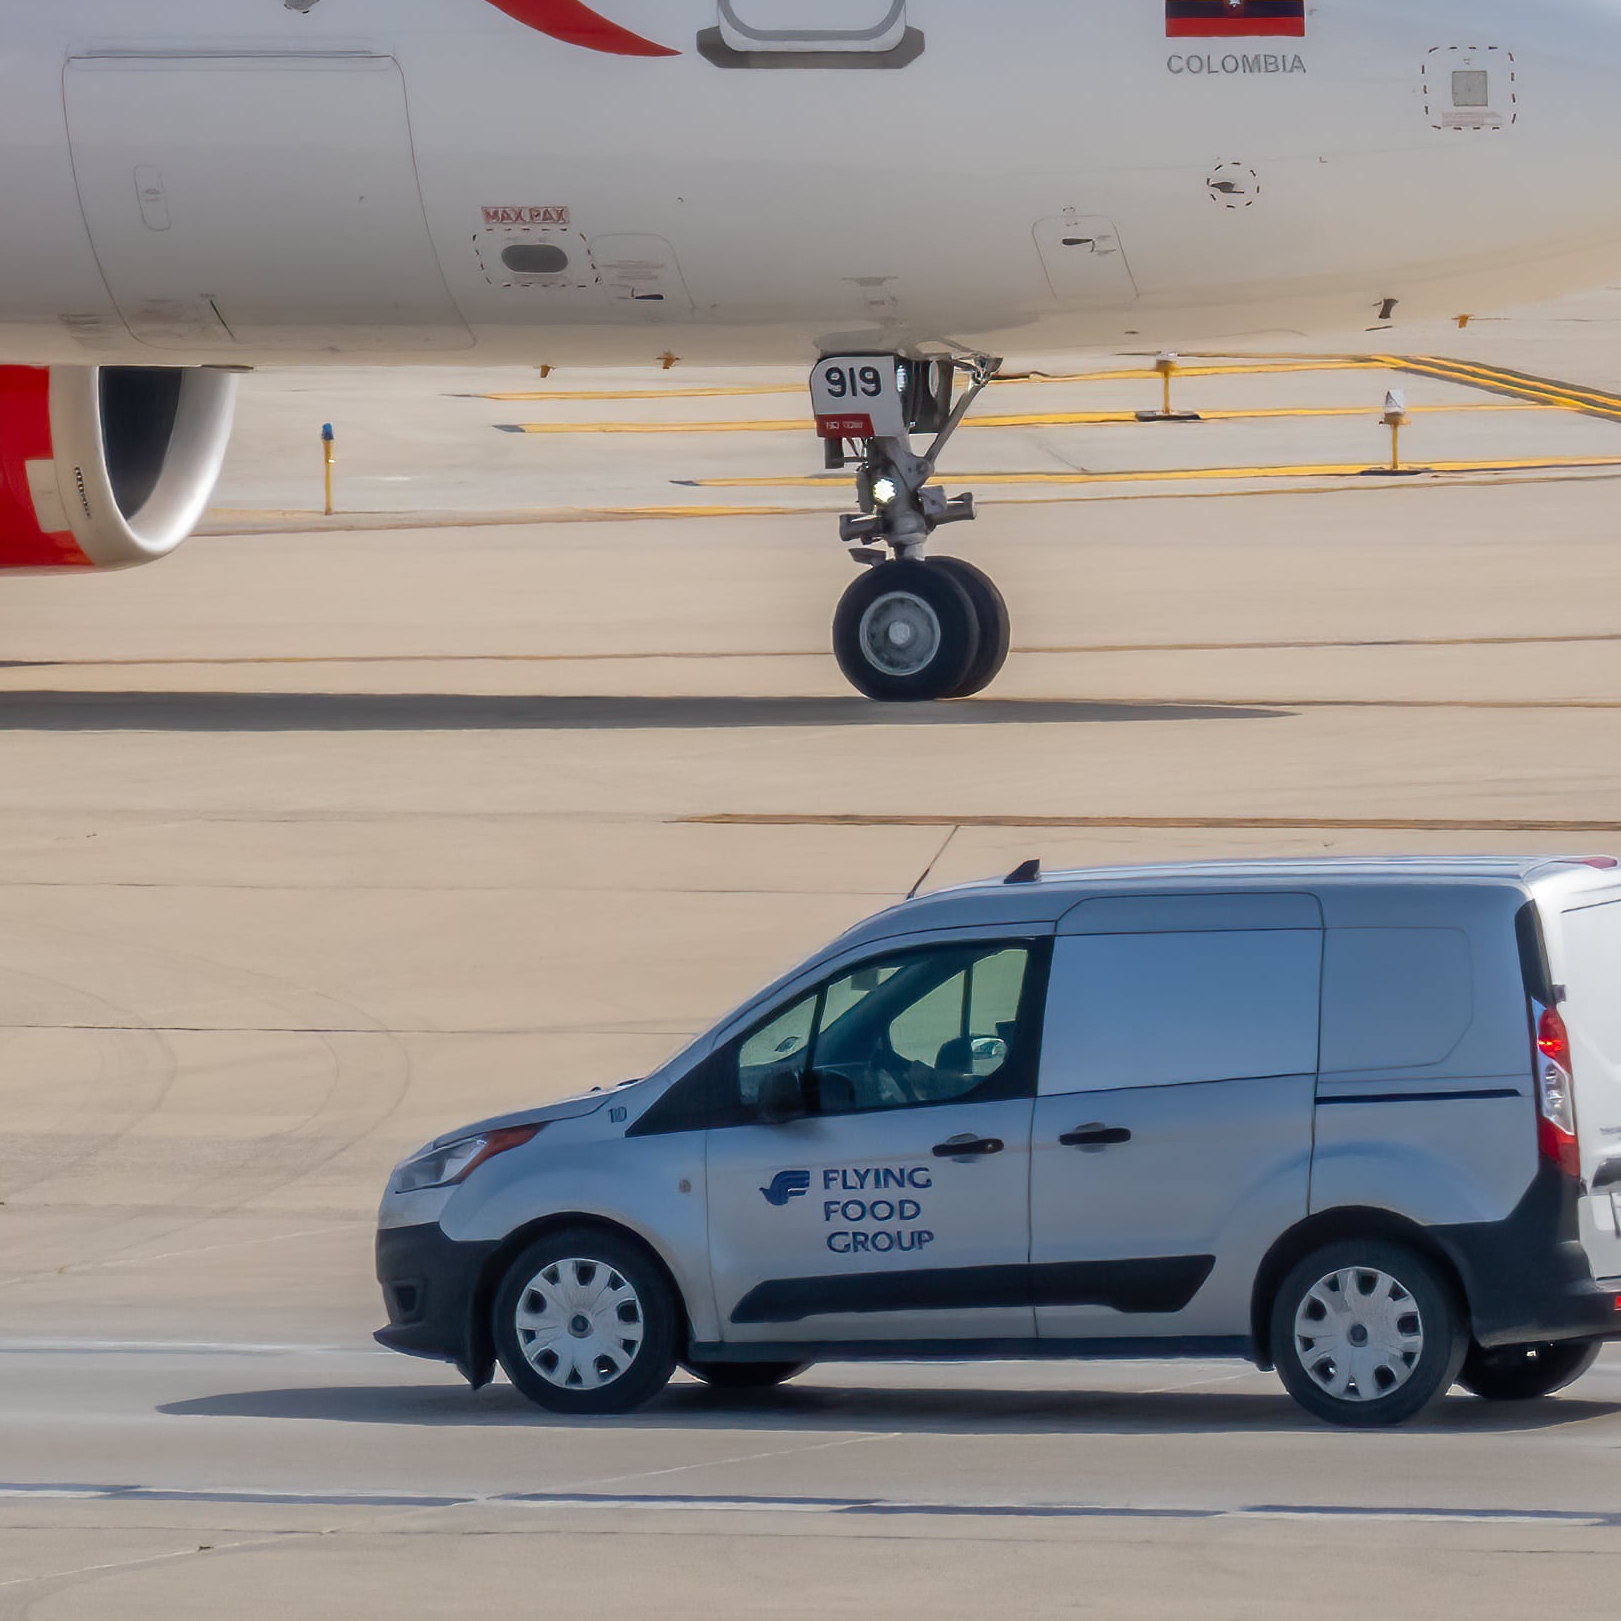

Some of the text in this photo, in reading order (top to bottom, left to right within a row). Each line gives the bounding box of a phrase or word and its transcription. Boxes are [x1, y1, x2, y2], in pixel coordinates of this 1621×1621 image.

[1166, 54, 1307, 74] COLOMBIA
[482, 207, 567, 223] MAX PAX
[825, 366, 882, 398] 919
[823, 1167, 932, 1190] FLYING
[824, 1199, 921, 1222] FOOD
[826, 1230, 934, 1253] GROUP
